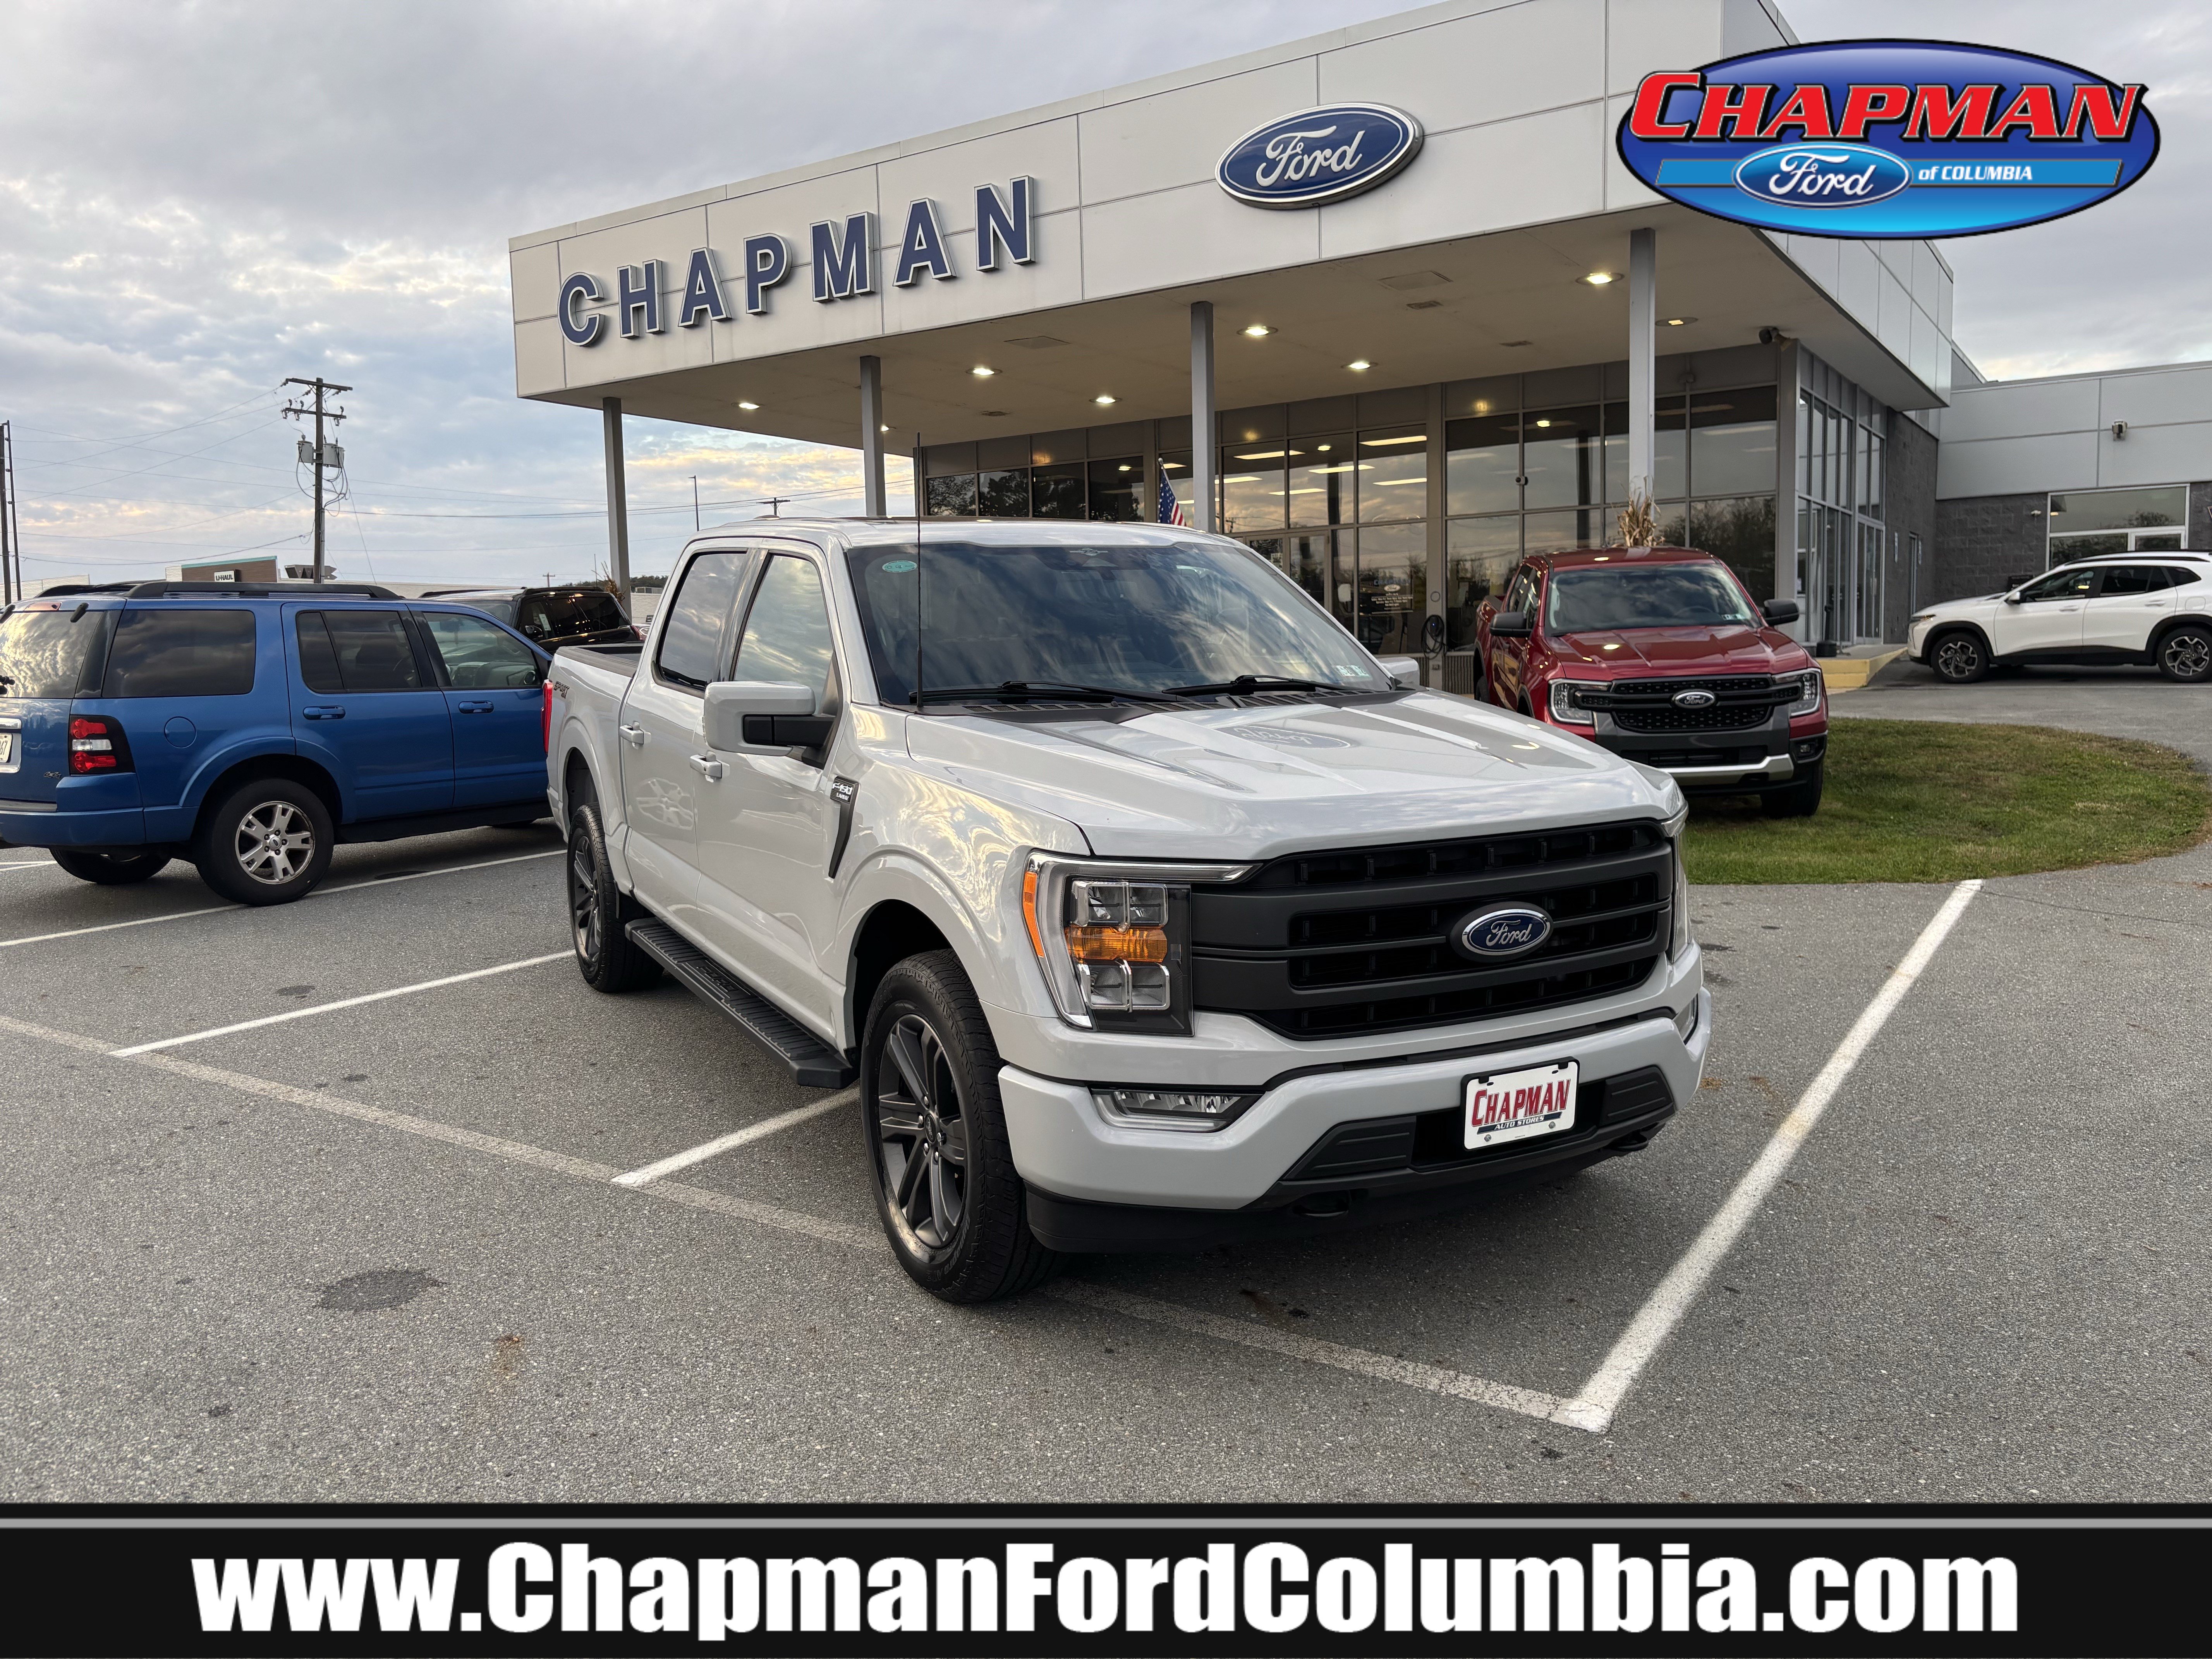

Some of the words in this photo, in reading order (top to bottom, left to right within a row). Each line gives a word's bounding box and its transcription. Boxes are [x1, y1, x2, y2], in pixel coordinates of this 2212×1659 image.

[1256, 126, 1365, 186] Ford
[558, 175, 1034, 347] CHAPMAN
[553, 682, 570, 695] SPORT
[1684, 695, 1705, 704] Ford
[832, 783, 853, 795] F-150
[1486, 919, 1532, 946] Ford
[1471, 1079, 1571, 1127] CHAPMAN
[1494, 1120, 1516, 1130] AUTO
[1516, 1115, 1544, 1127] STORES
